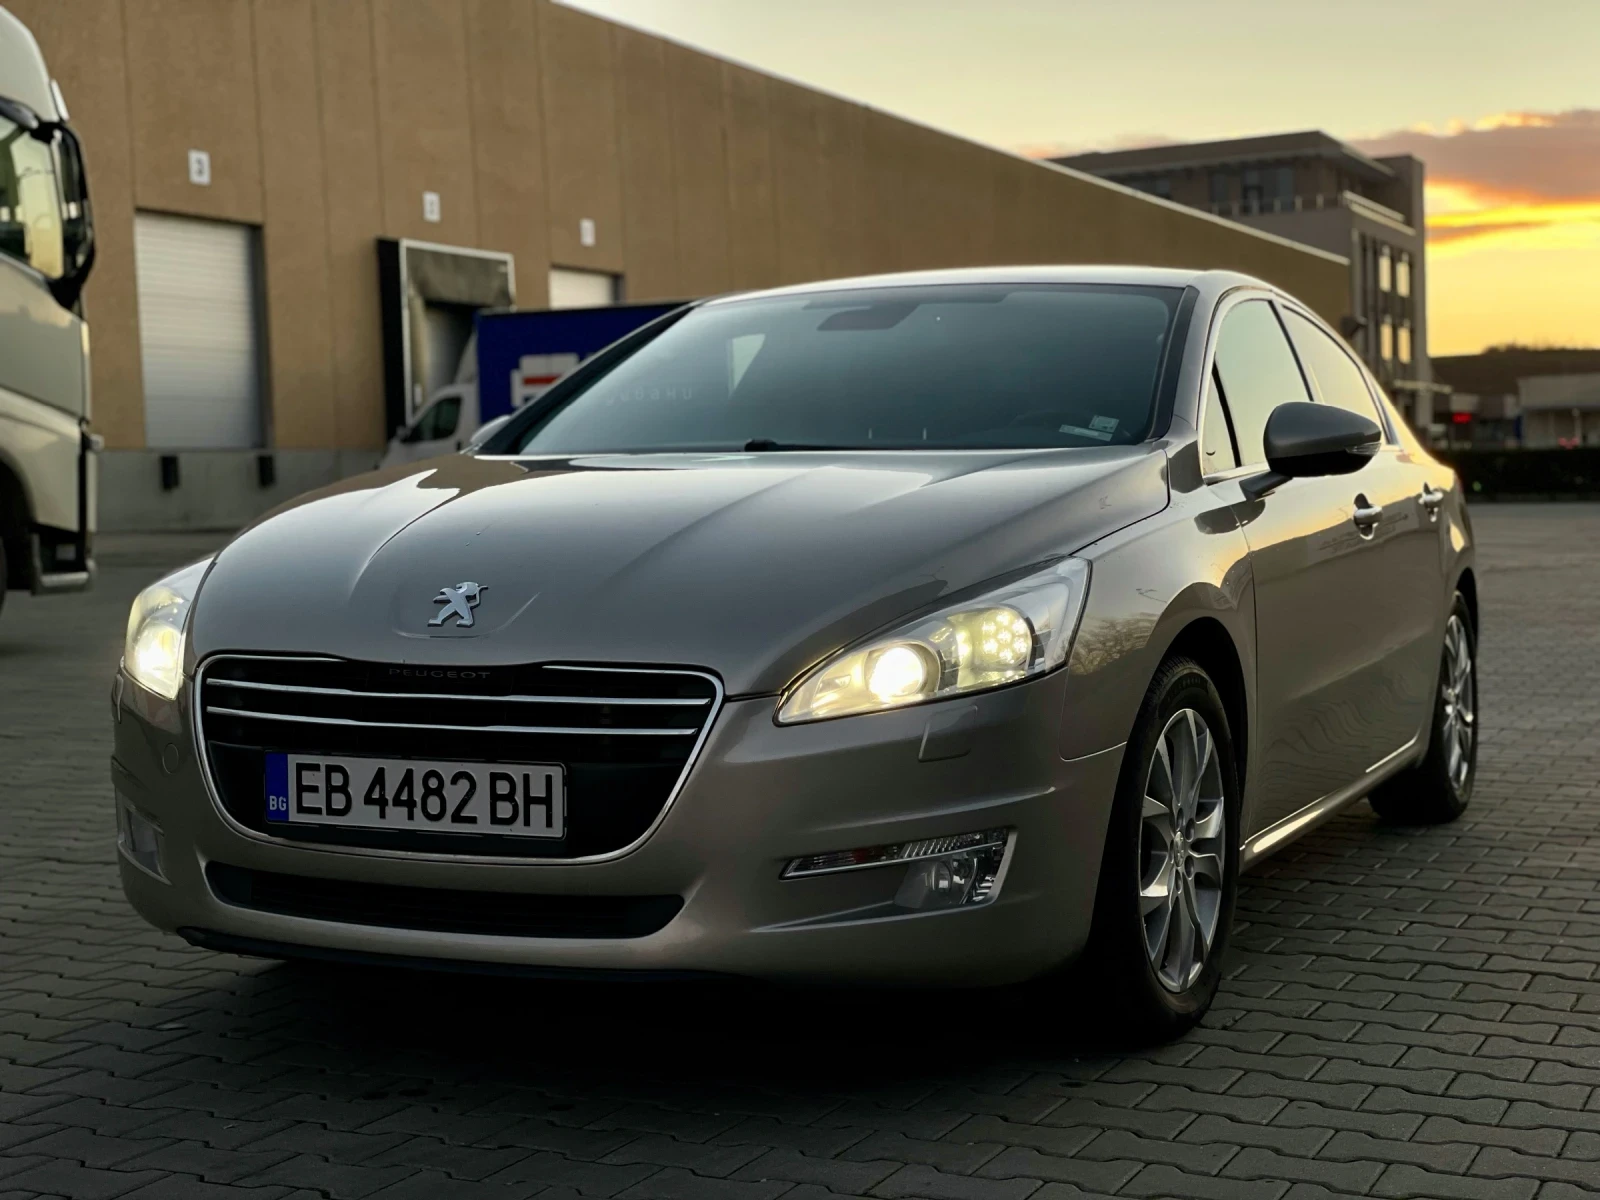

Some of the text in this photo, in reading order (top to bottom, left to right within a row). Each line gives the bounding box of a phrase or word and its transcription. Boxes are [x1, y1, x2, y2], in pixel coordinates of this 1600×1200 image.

[389, 668, 491, 679] PEUGEOT
[269, 795, 287, 811] BG
[295, 762, 553, 829] EB 4482 BH
